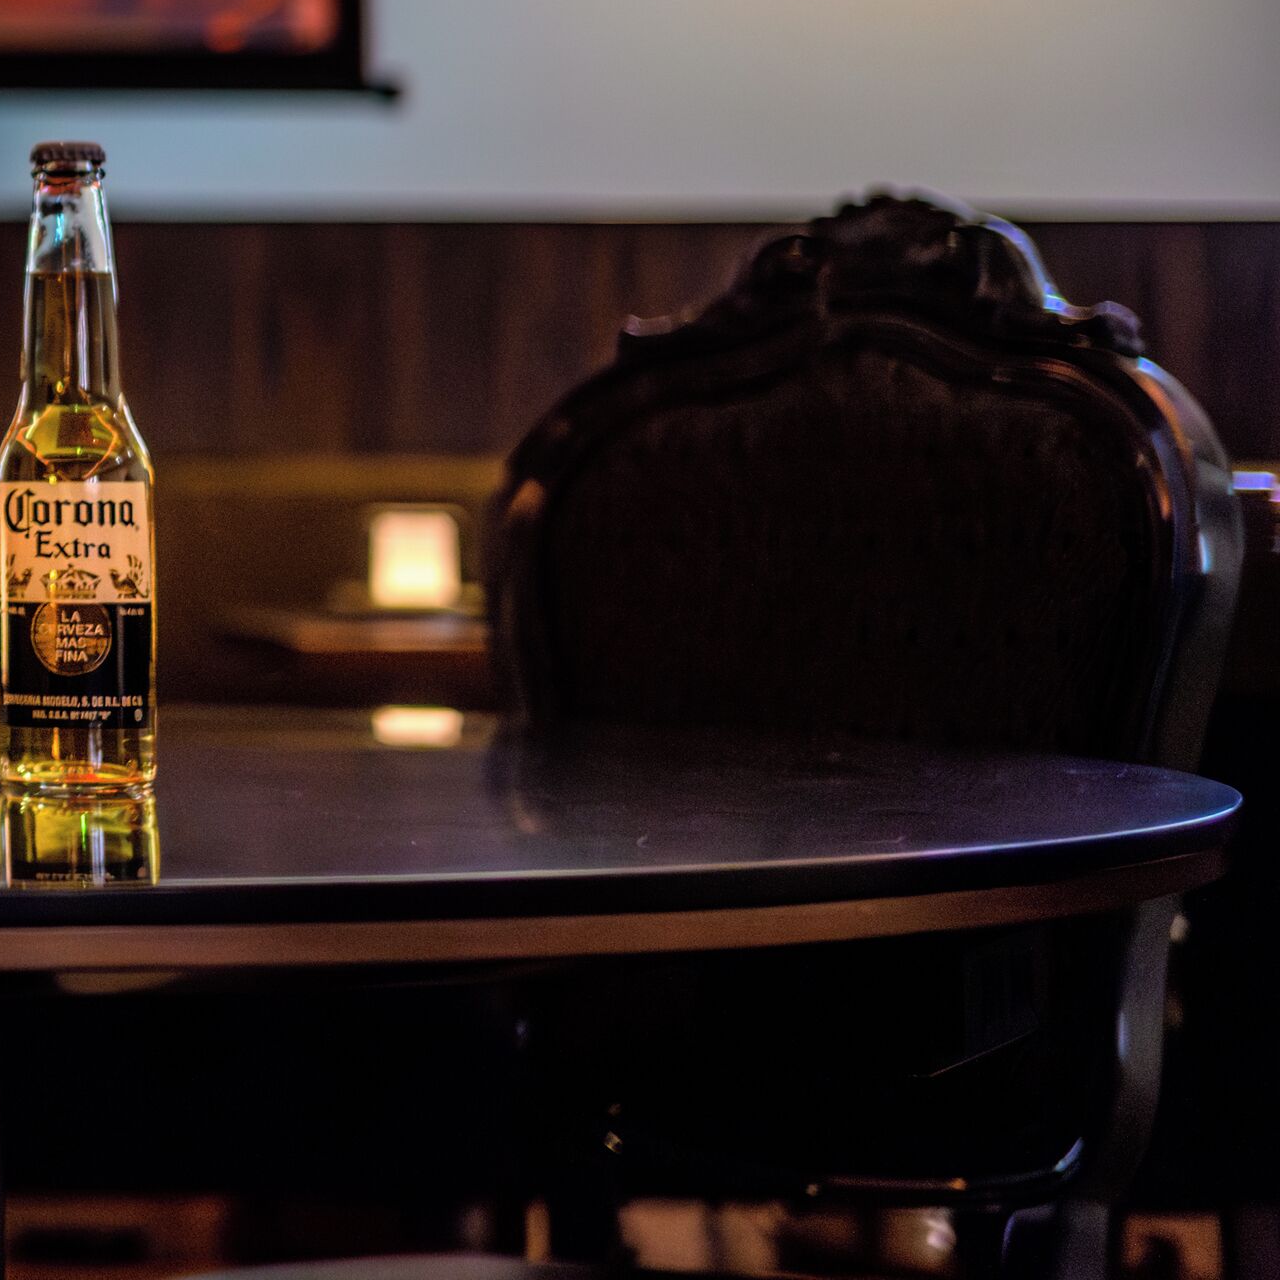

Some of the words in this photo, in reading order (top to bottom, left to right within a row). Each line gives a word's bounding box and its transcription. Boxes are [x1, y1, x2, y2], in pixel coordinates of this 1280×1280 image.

[5, 489, 135, 538] Corona
[35, 531, 111, 559] Extra
[61, 610, 81, 623] LA
[56, 650, 89, 663] FINA
